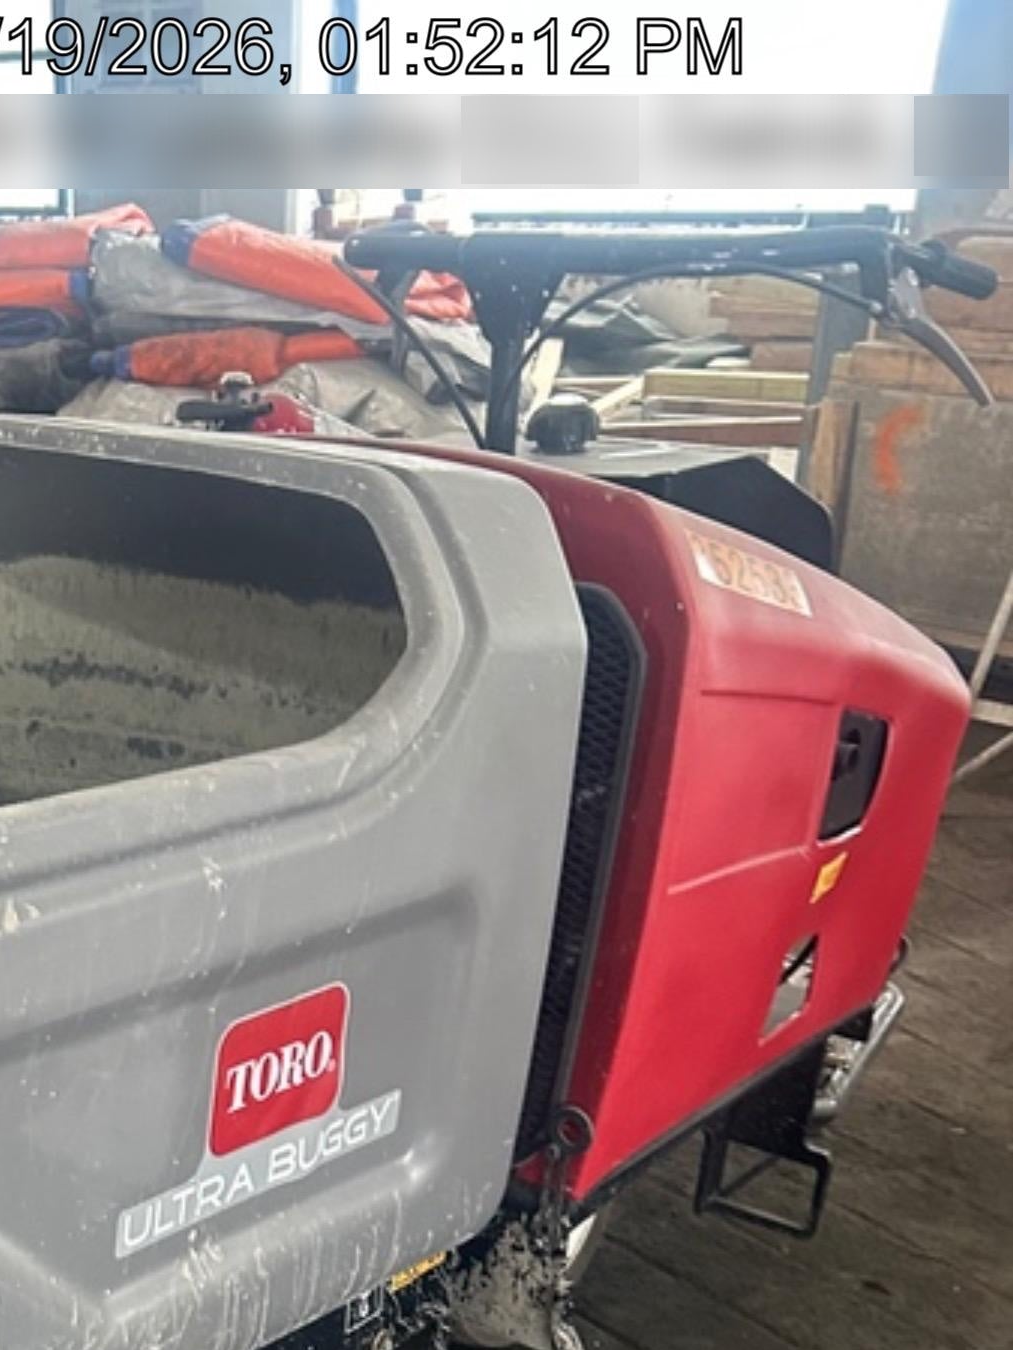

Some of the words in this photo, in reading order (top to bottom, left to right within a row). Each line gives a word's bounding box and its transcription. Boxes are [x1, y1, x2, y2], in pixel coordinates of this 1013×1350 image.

[225, 1030, 334, 1114] TORO
[122, 1162, 255, 1248] ULTRA
[268, 1100, 392, 1183] BUGGY
